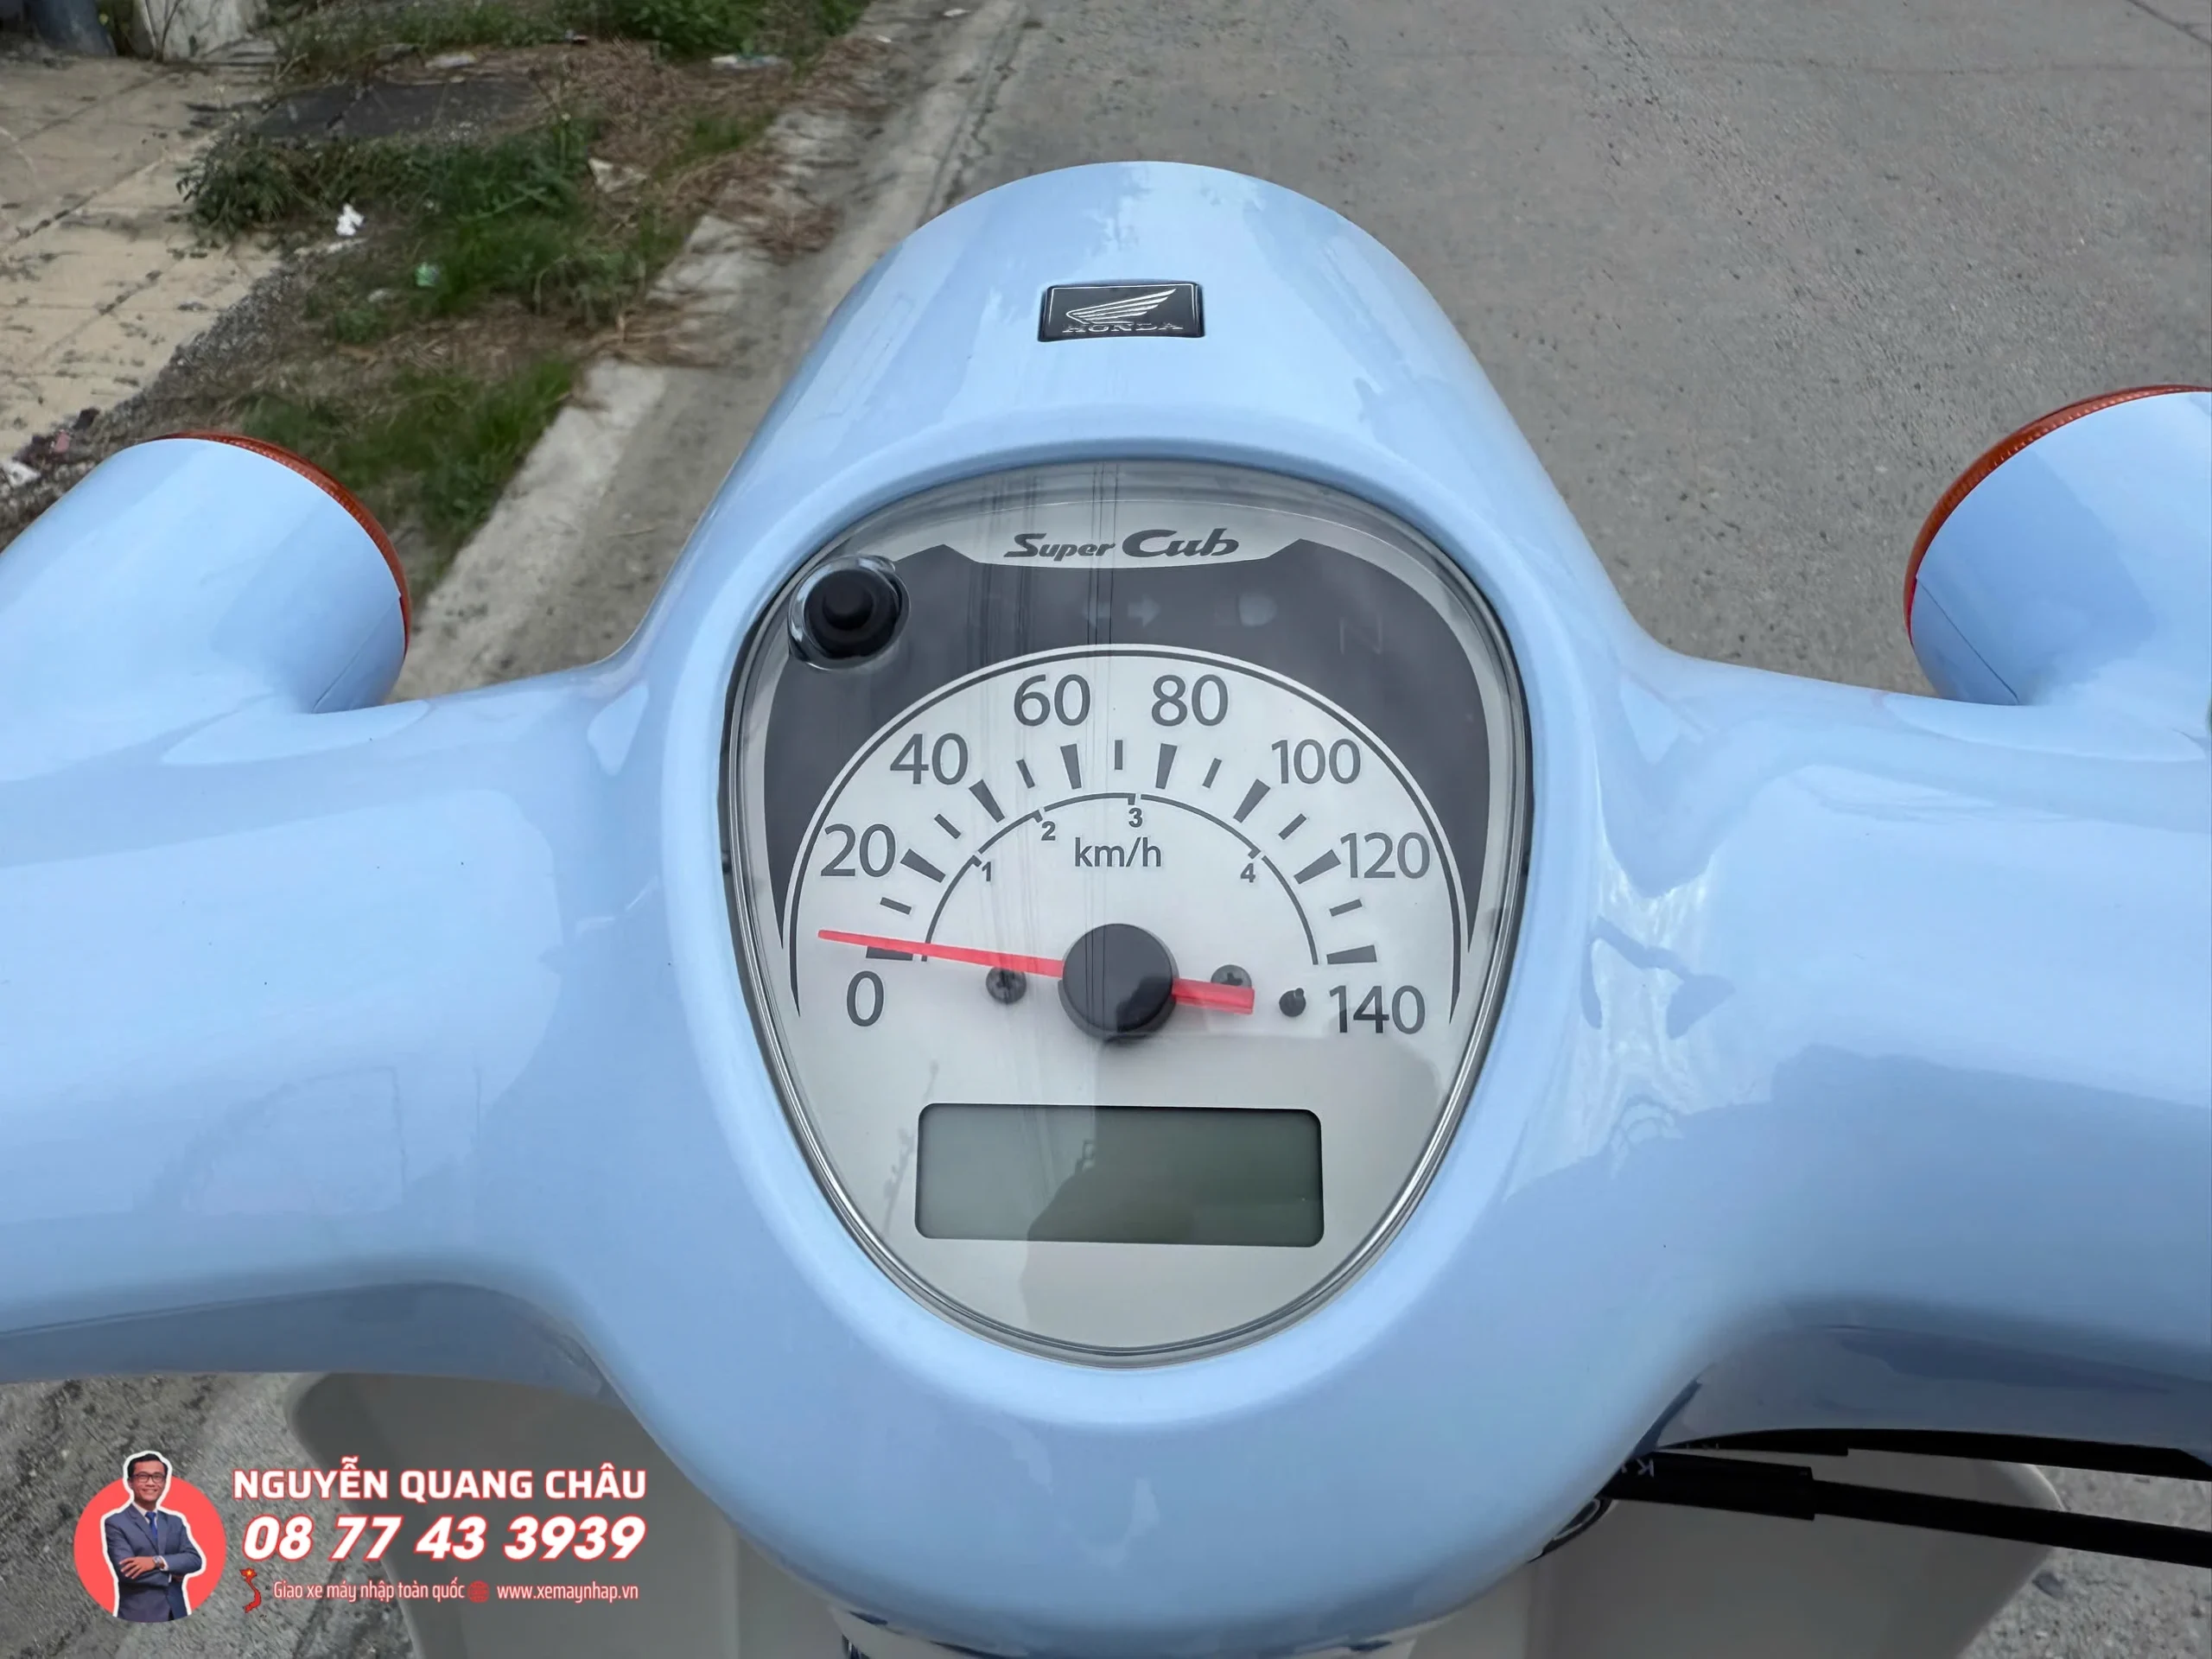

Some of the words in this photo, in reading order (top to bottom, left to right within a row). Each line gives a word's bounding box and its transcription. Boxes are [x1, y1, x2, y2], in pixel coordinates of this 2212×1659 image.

[1061, 322, 1185, 334] HONDA
[1003, 532, 1116, 562] Super
[1122, 527, 1239, 558] Cub
[1014, 674, 1091, 727] 60
[1151, 674, 1229, 727] 80
[890, 733, 969, 785] 40
[1271, 739, 1362, 785] 100
[1040, 822, 1056, 842] 2
[1128, 808, 1143, 830] 3
[820, 823, 897, 878] 20
[981, 862, 992, 882] 1
[1074, 835, 1162, 869] km/h
[1240, 862, 1256, 884] 4
[1340, 832, 1431, 880] 120
[846, 970, 884, 1027] 0
[1329, 984, 1426, 1035] 140
